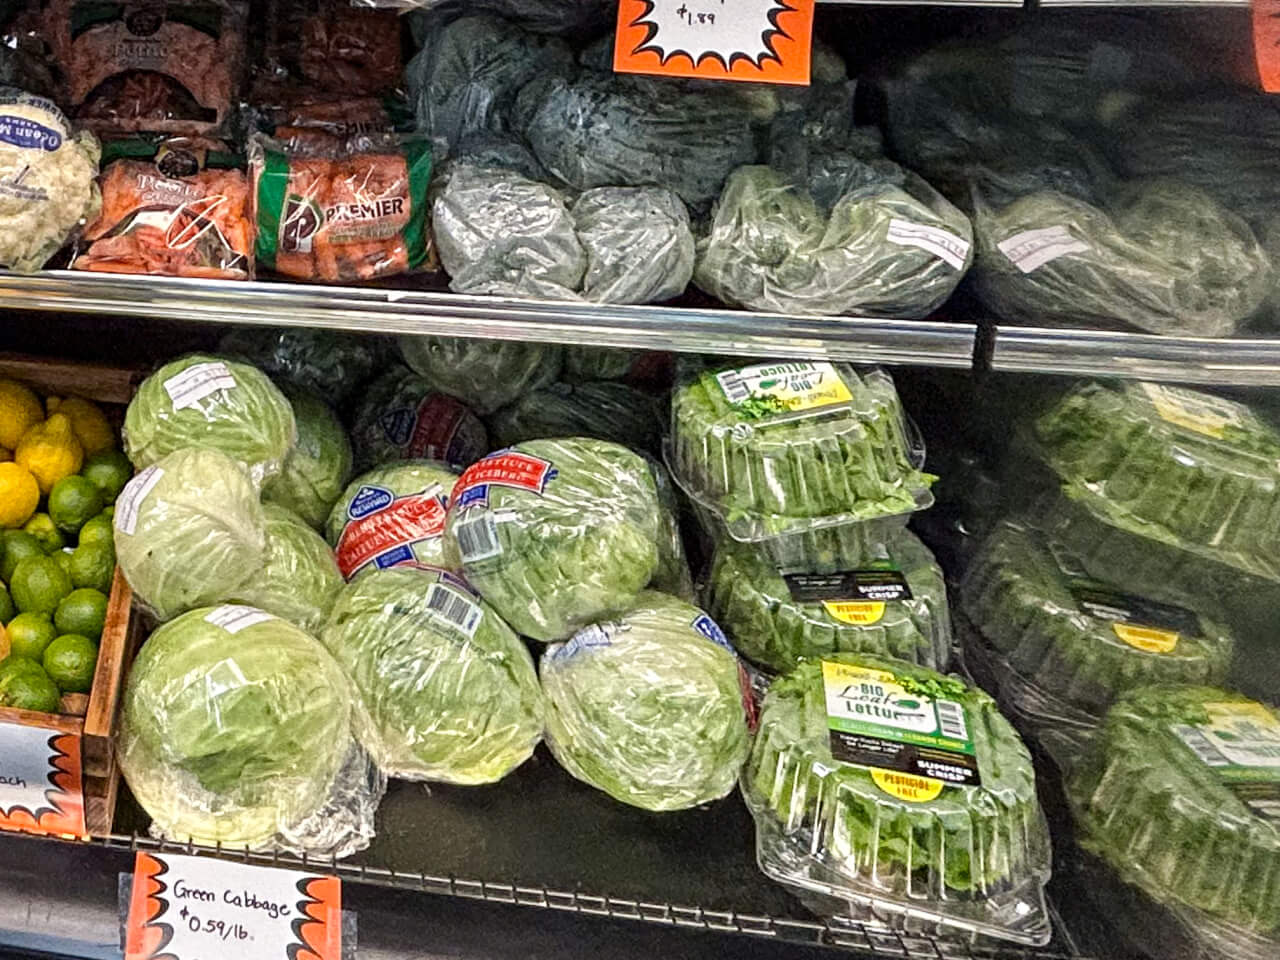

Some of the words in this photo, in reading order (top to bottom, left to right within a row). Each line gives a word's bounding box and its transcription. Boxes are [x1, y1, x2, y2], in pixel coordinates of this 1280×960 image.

[16, 126, 59, 148] Ocean
[326, 198, 404, 222] PREMIER
[860, 683, 884, 697] BIG
[917, 760, 973, 777] SUMMER
[926, 770, 966, 781] CRISP
[173, 879, 216, 902] Green
[223, 889, 292, 919] Cabbage
